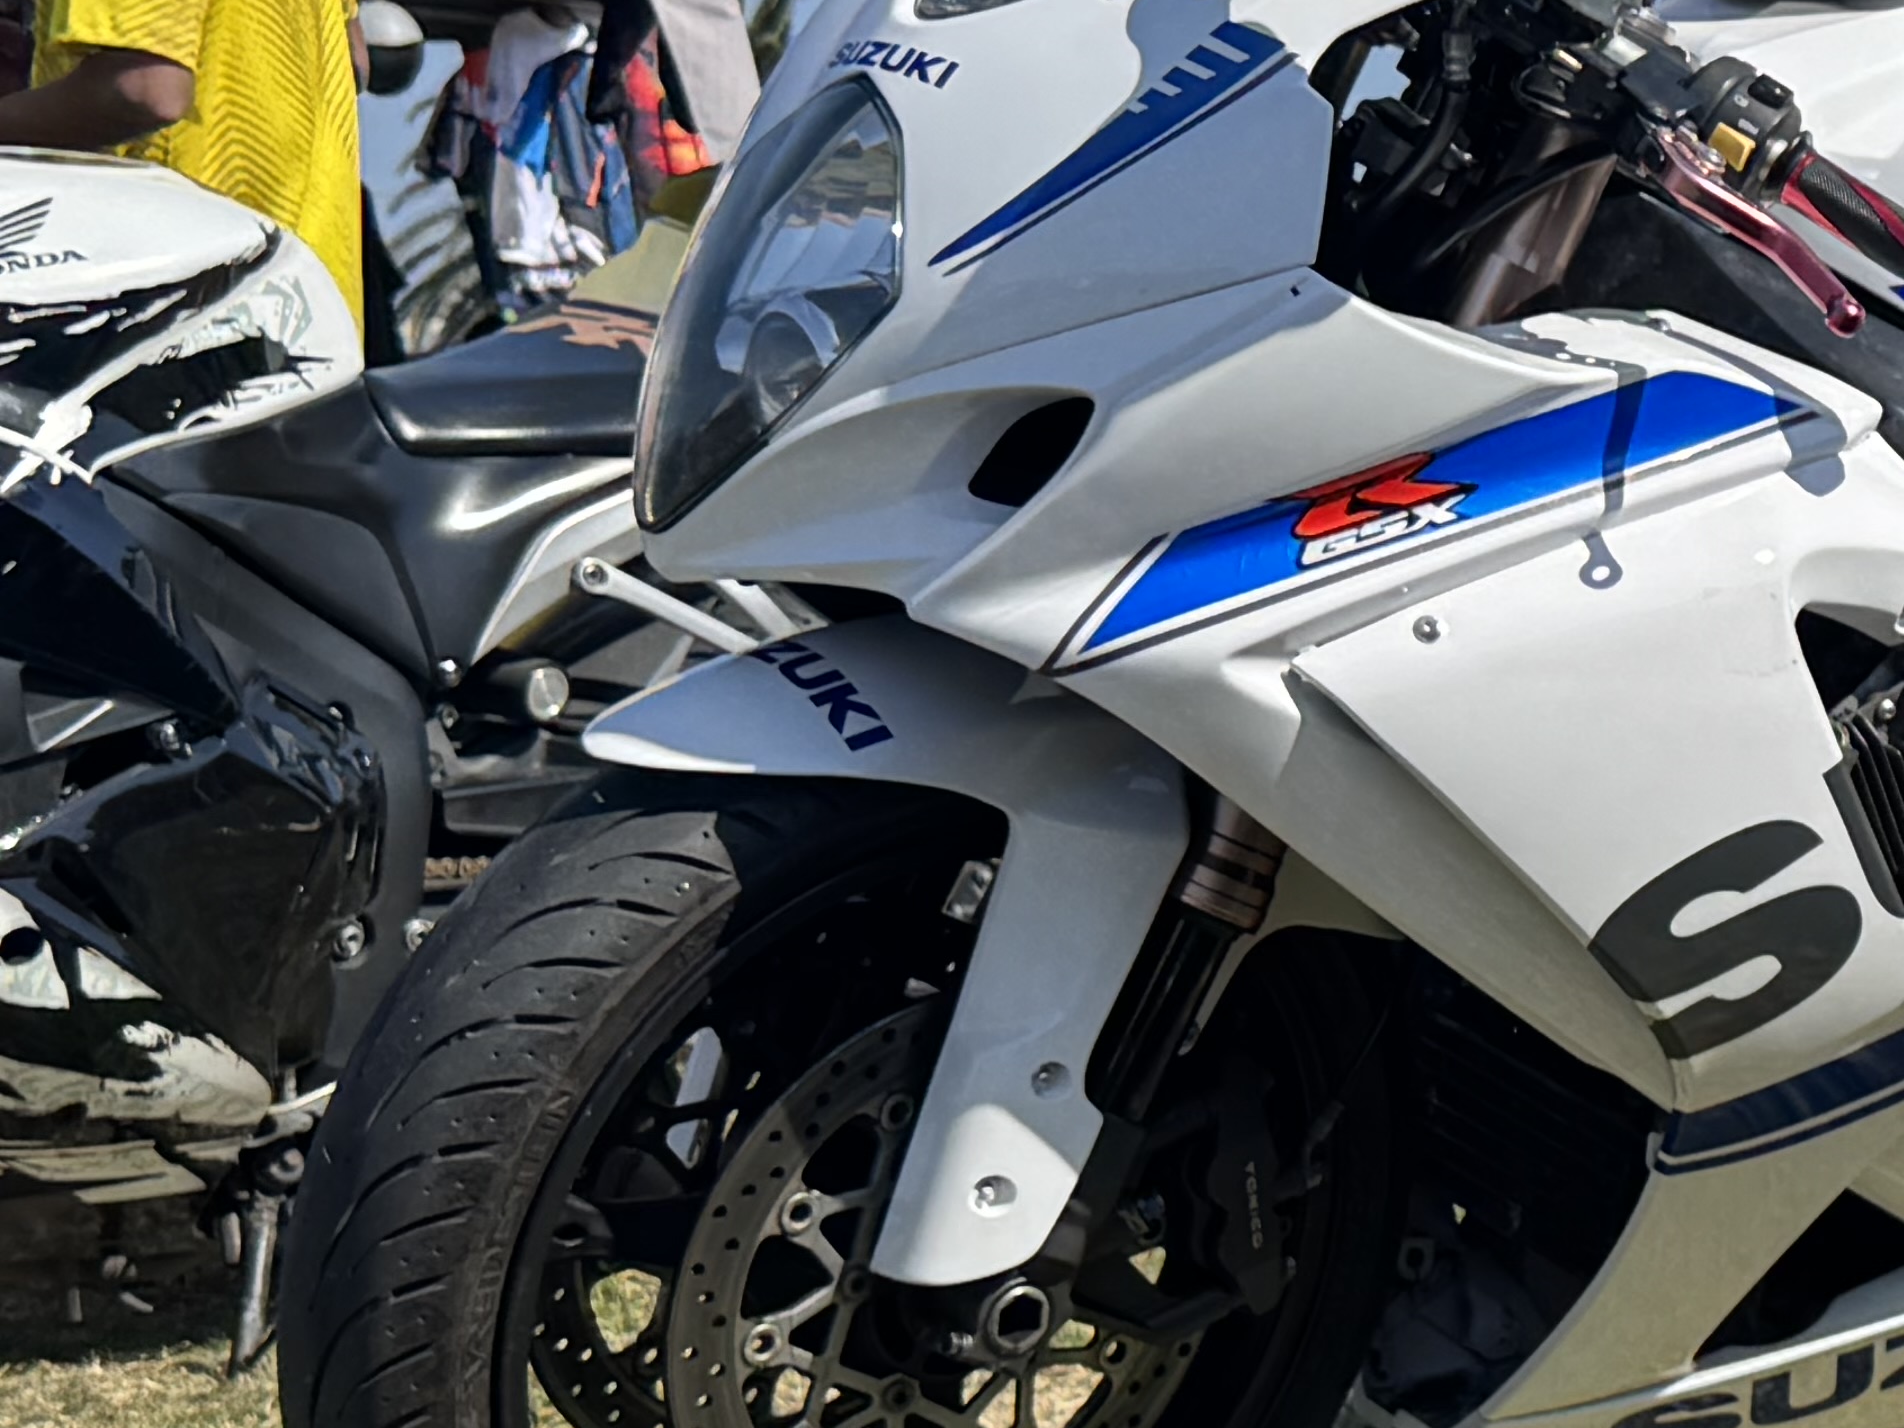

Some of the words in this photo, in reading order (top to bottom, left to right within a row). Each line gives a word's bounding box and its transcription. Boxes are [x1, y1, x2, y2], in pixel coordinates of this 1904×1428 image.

[828, 40, 960, 90] SUZUKI
[0, 249, 89, 275] NDA
[1300, 491, 1470, 567] GSX
